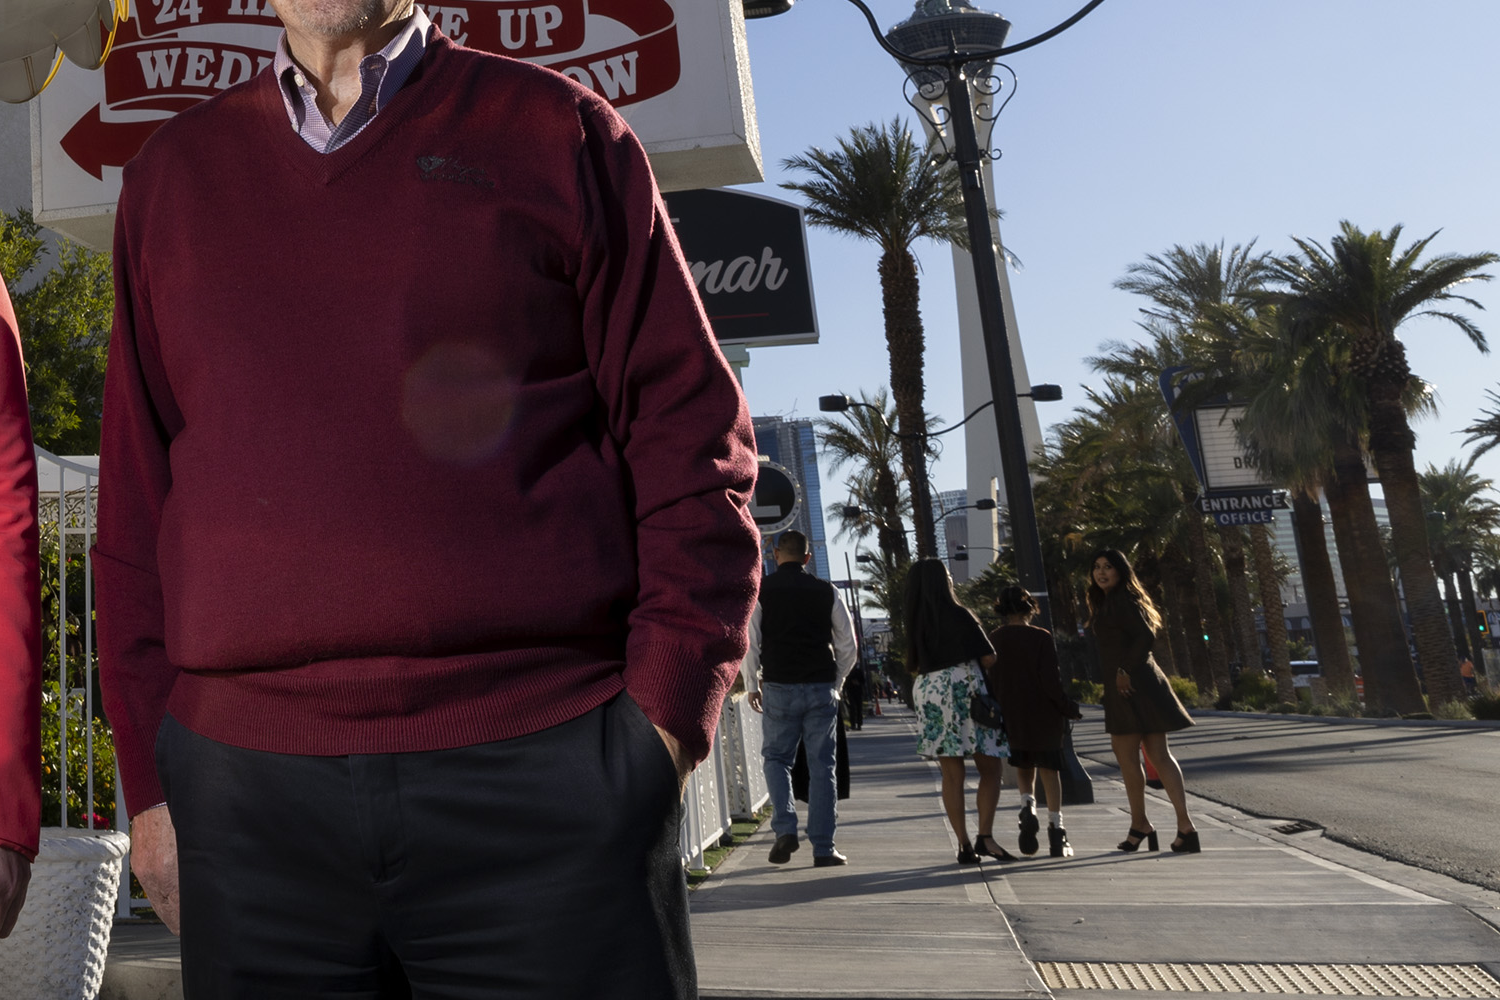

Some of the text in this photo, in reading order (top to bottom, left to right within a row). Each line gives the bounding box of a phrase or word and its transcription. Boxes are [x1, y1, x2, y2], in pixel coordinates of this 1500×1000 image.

[497, 4, 563, 50] UP
[1201, 494, 1282, 512] ENTRANCE
[1220, 511, 1269, 525] OFFICE
